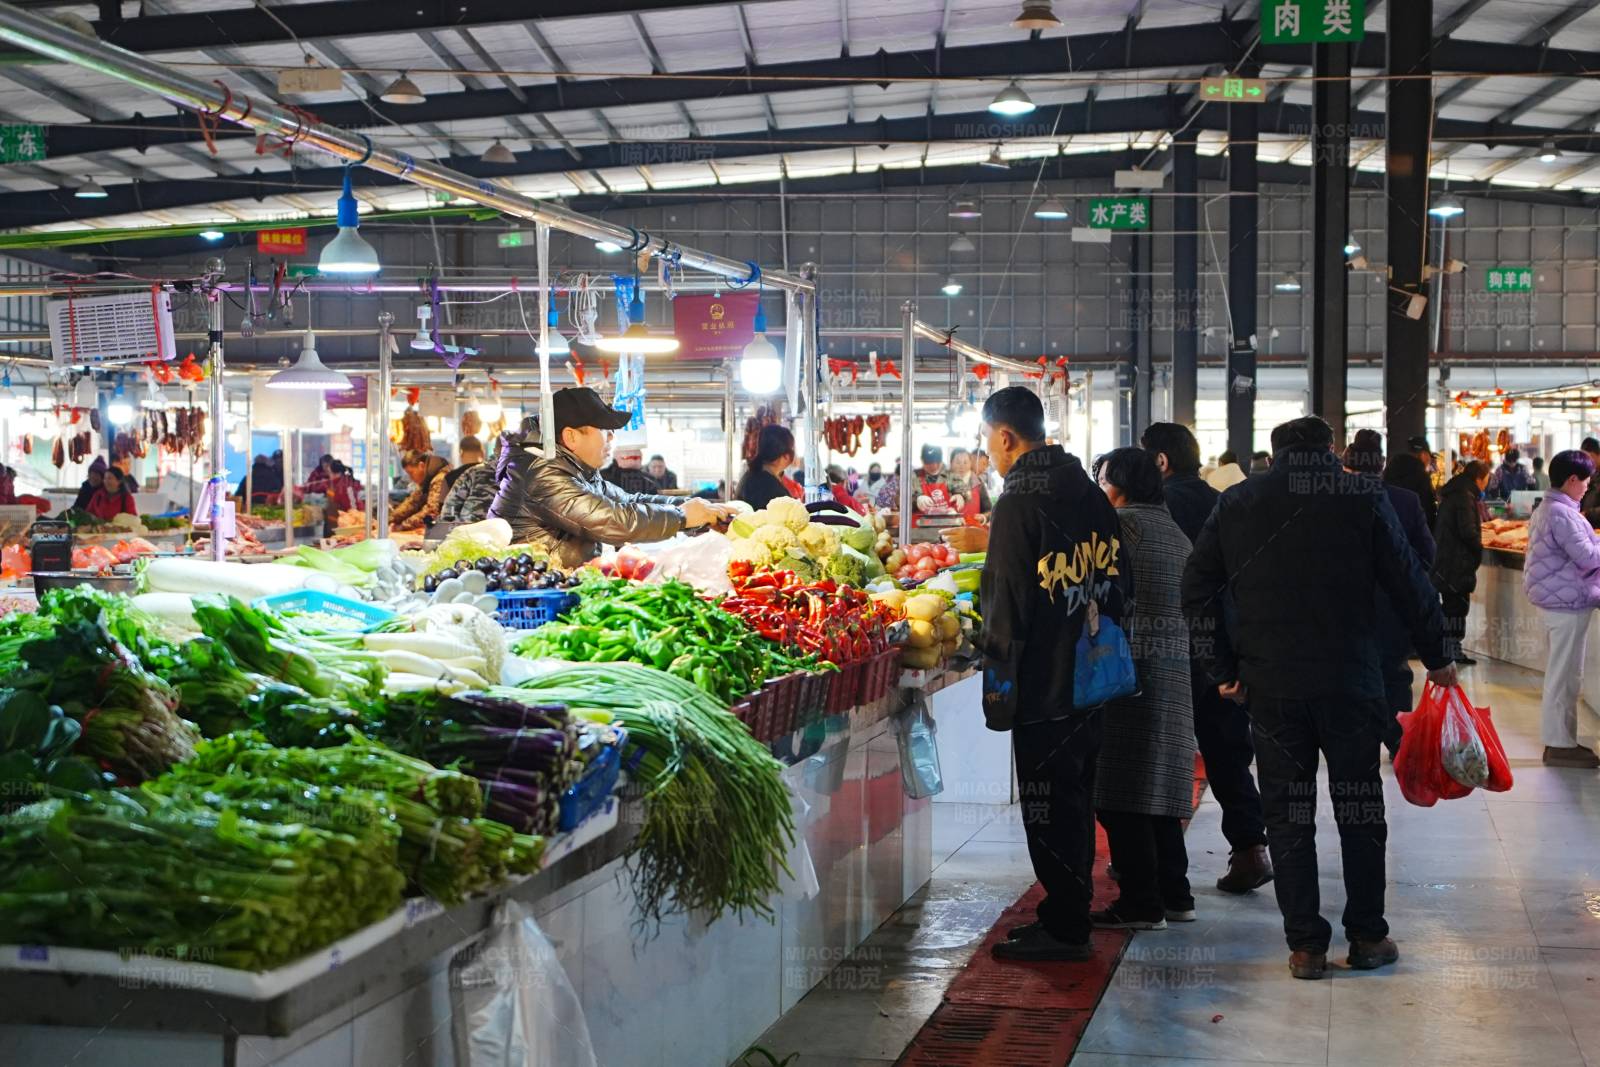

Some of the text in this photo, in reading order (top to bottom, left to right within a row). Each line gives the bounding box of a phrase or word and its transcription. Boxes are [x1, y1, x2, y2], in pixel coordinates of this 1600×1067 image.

[1275, 0, 1352, 37] 肉类
[1092, 202, 1146, 224] 水产类
[1489, 271, 1531, 288] 狗羊肉
